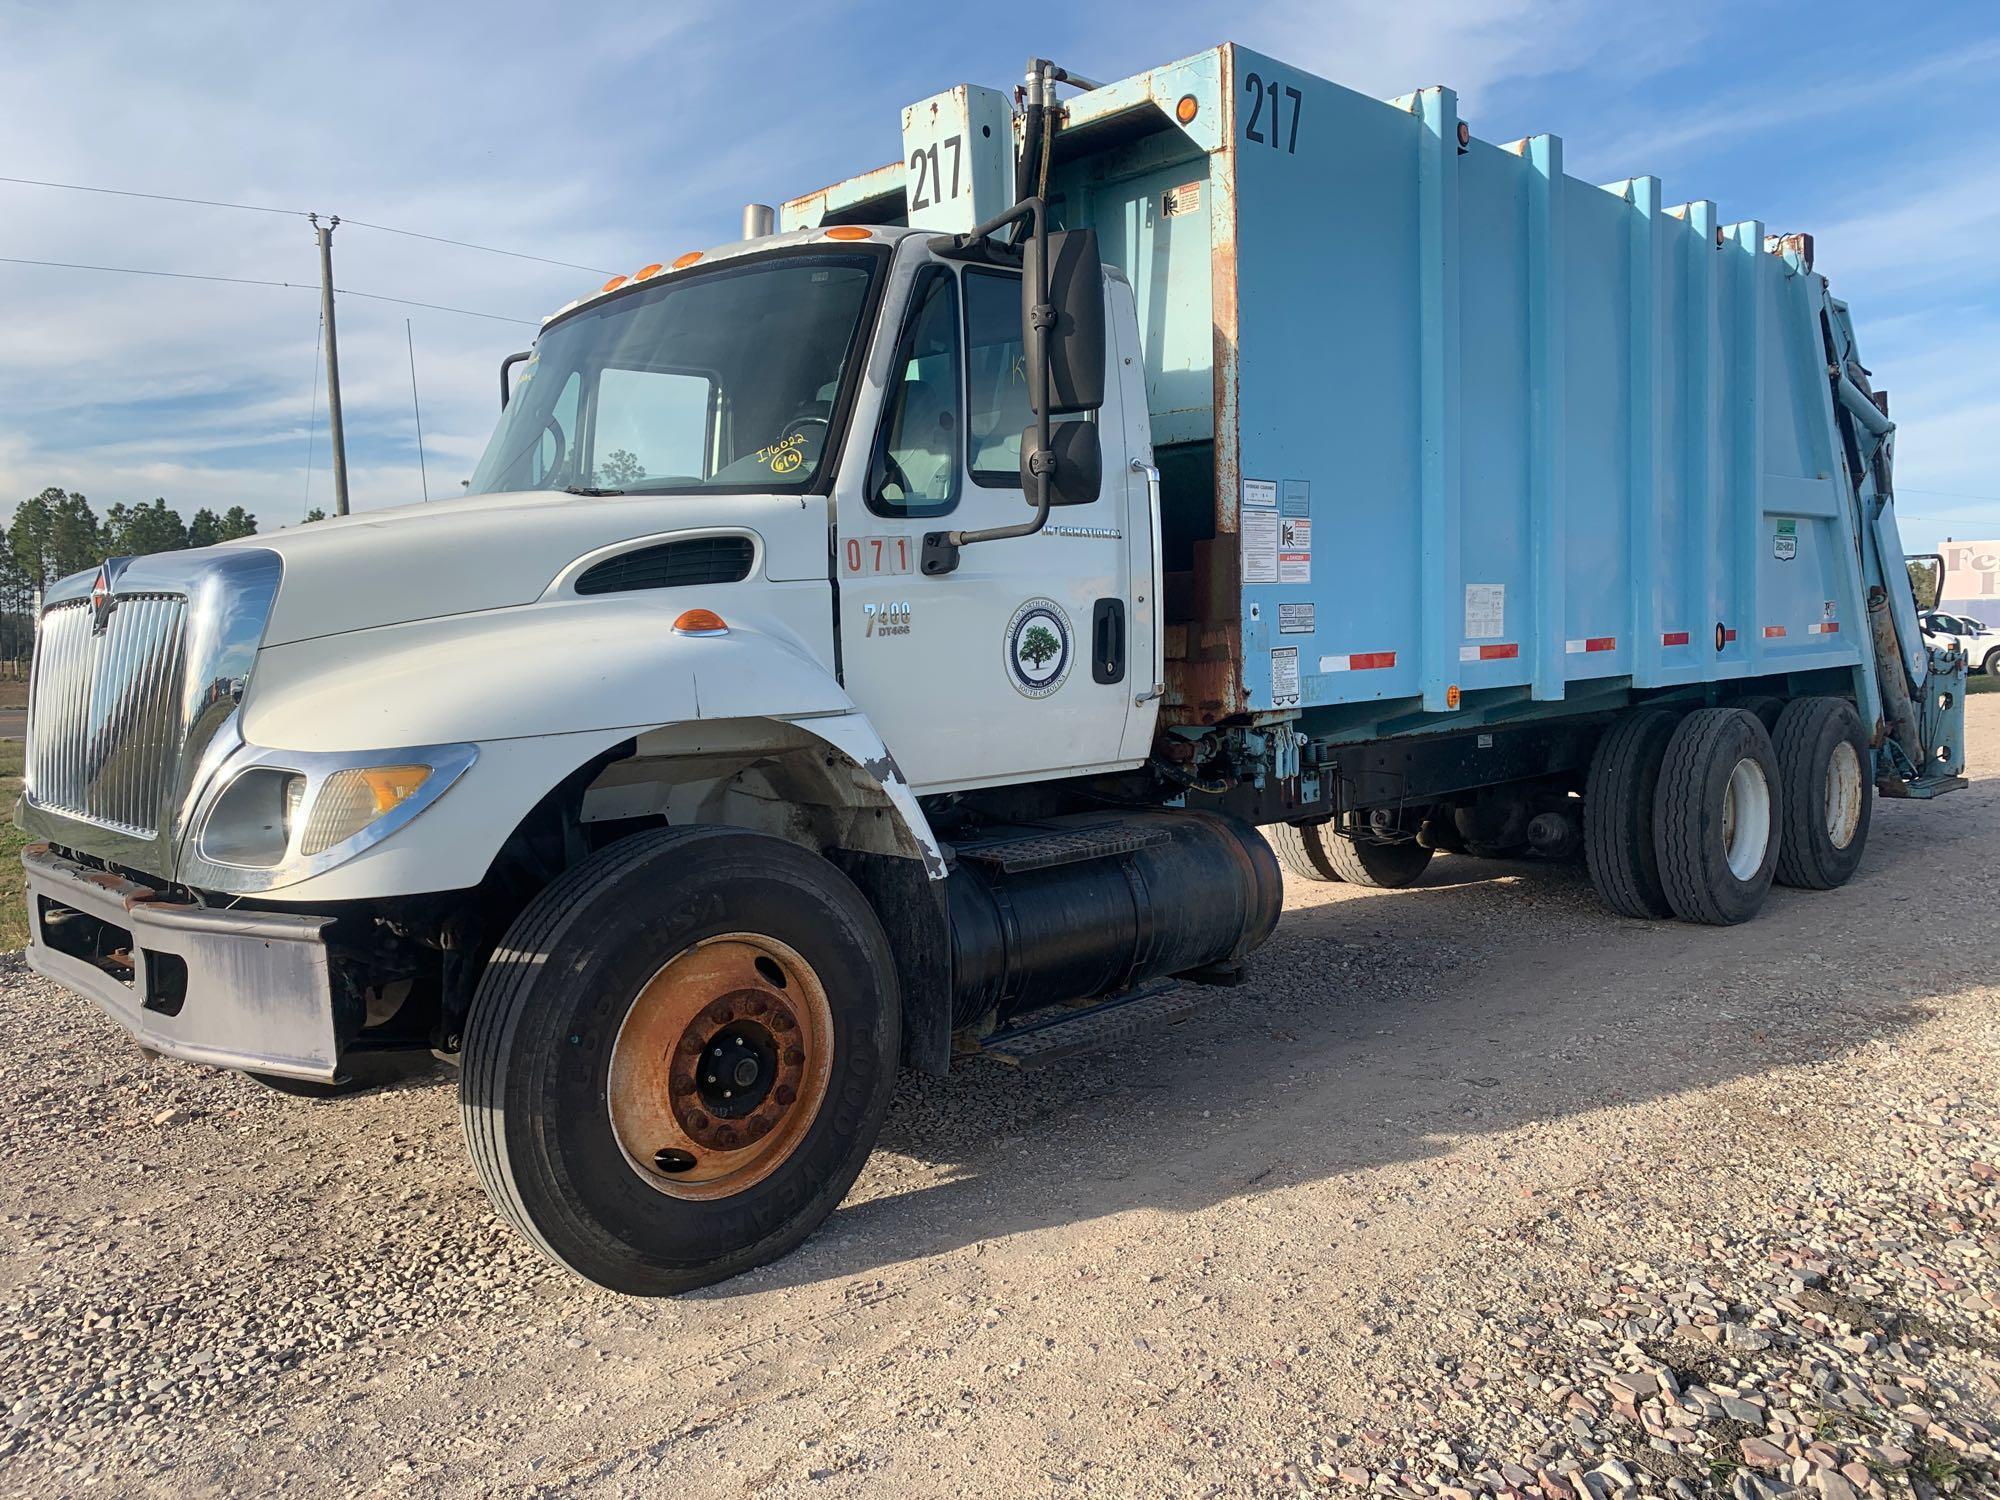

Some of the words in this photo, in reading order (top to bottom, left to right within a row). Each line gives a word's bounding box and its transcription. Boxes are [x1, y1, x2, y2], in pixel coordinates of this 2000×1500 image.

[1245, 72, 1302, 155] 217
[910, 135, 962, 212] 217
[775, 453, 799, 471] 619
[1042, 525, 1122, 540] INTERNATIONAL
[846, 538, 908, 573] 071
[1945, 546, 2000, 572] Fe
[863, 600, 911, 638] 7400
[879, 625, 911, 637] DT466
[1020, 600, 1040, 616] NORTH
[1040, 600, 1071, 633] CHARLESTON
[1038, 674, 1067, 697] CAROLINA
